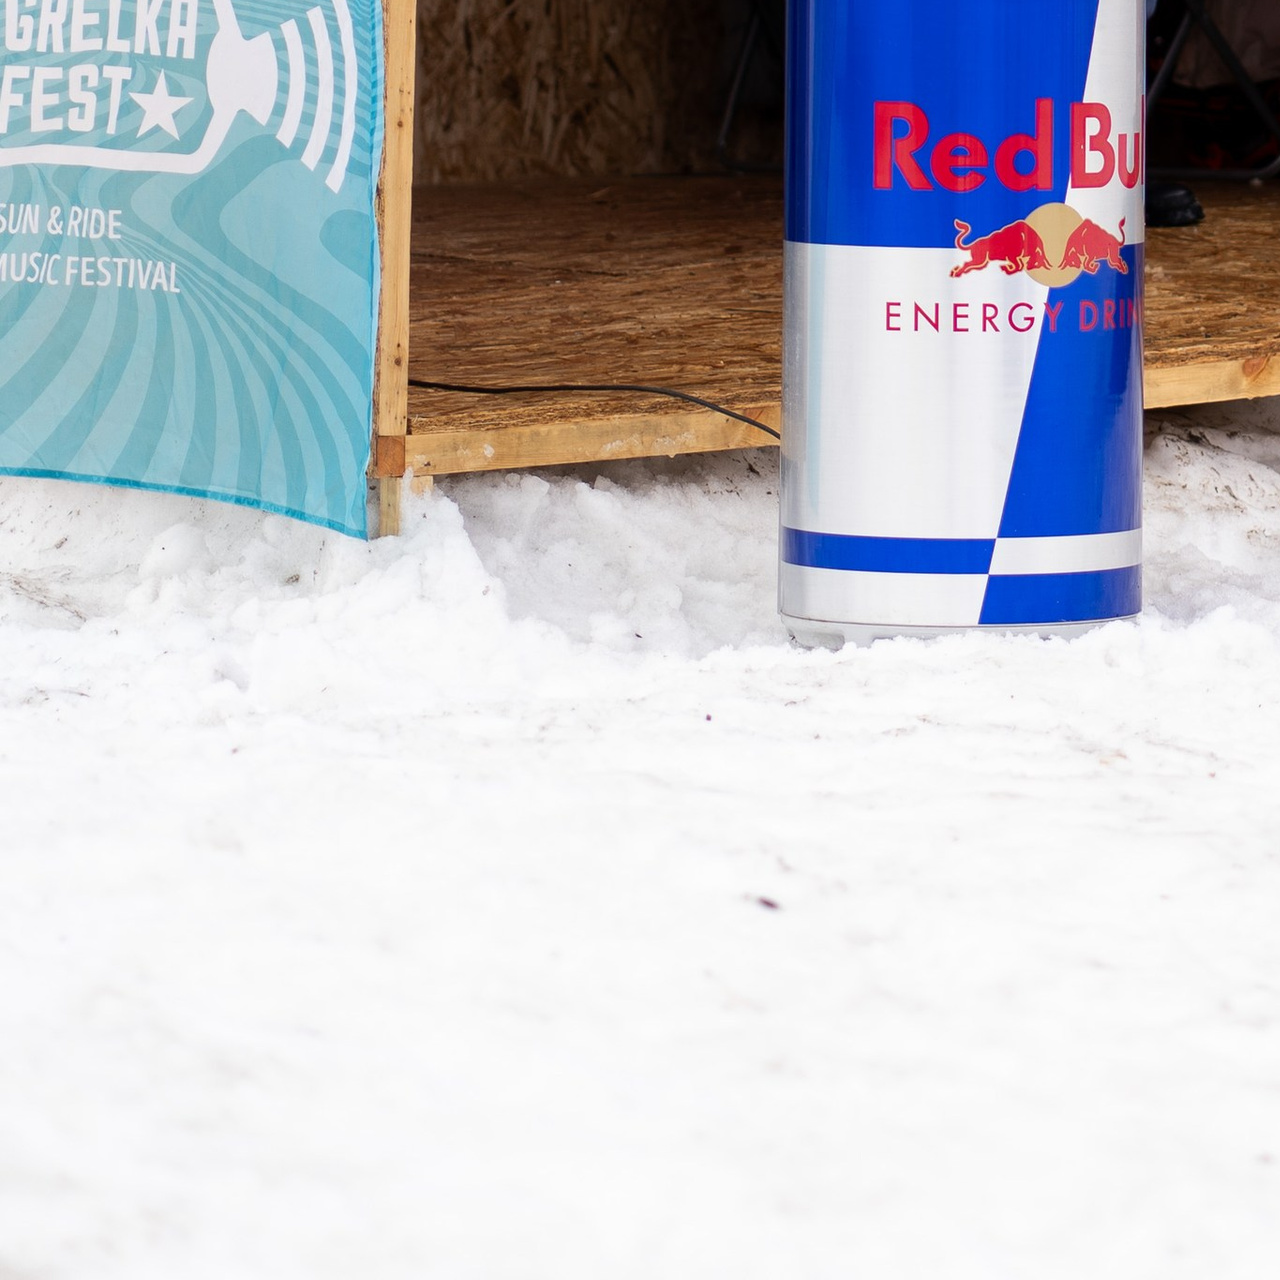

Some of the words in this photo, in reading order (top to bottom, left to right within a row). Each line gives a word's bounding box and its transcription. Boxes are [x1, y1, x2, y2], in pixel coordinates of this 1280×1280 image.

[0, 63, 132, 135] FEST
[872, 97, 1054, 193] Red
[0, 203, 40, 235] SUN
[46, 205, 64, 236] &
[66, 205, 123, 240] RIDE
[65, 255, 181, 294] FESTIVAL
[885, 299, 1065, 333] ENERGY
